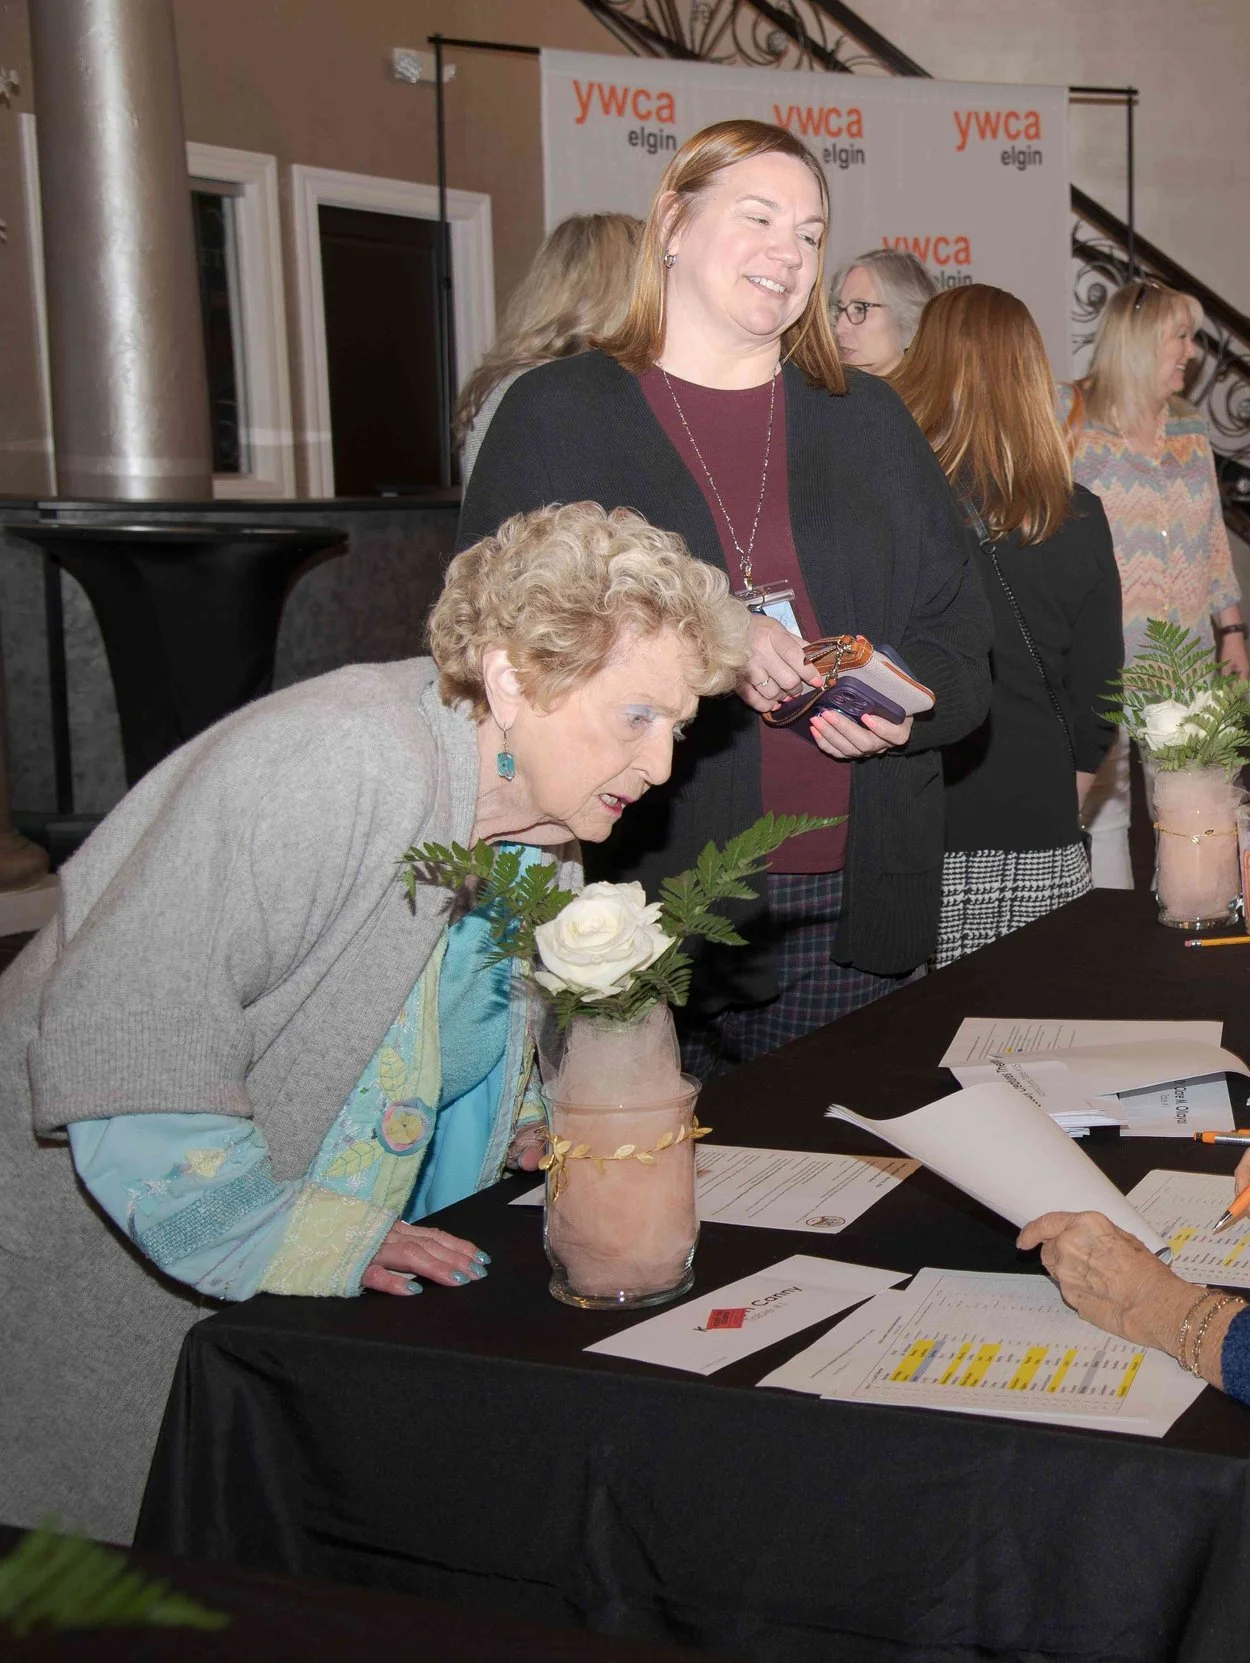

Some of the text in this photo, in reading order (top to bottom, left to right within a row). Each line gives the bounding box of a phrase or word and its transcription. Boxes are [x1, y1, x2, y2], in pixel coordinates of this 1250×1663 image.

[572, 79, 676, 125] ywca
[627, 126, 677, 155] elgin
[953, 110, 1042, 153] ywca
[823, 143, 865, 170] elgin
[1000, 144, 1043, 172] elgin
